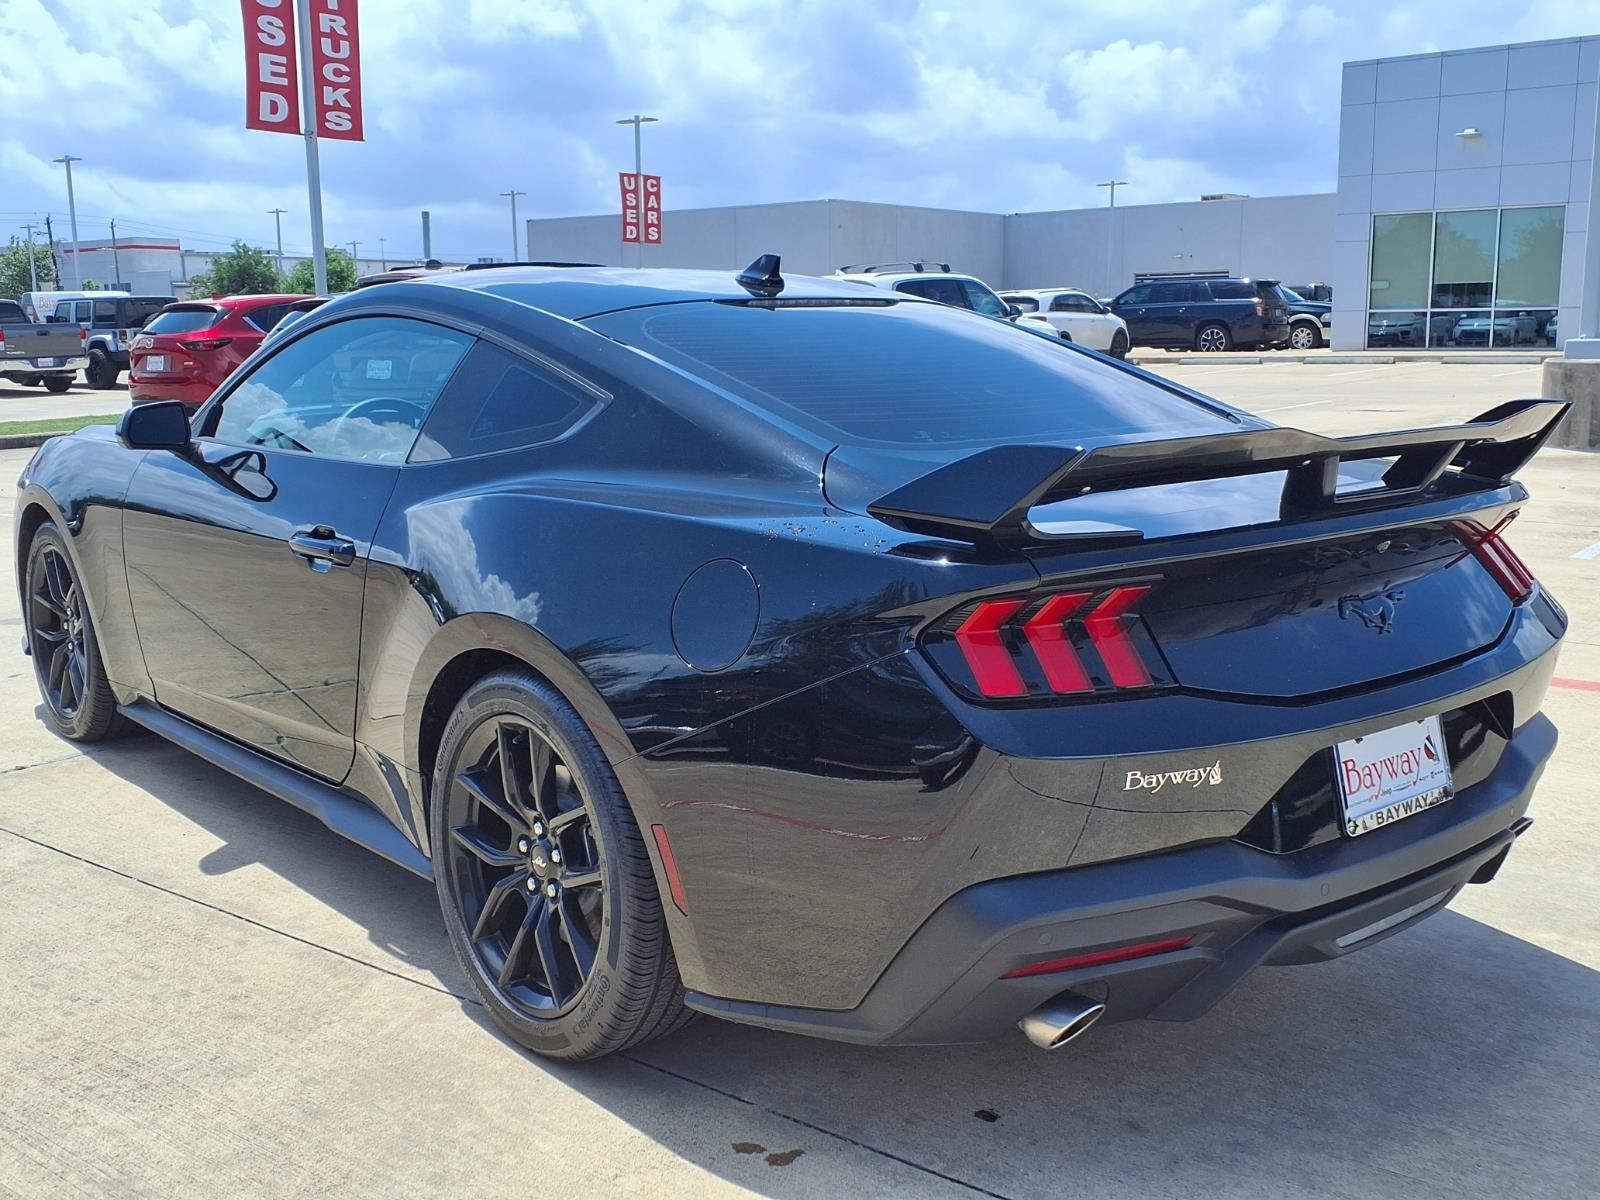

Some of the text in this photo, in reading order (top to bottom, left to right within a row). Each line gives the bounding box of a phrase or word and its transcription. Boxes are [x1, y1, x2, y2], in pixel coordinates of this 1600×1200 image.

[256, 0, 288, 122] SED
[623, 176, 638, 239] USED
[646, 178, 659, 241] CARS
[1122, 766, 1212, 794] Bayway
[1342, 748, 1421, 800] Bayway
[1375, 793, 1429, 825] BAYWAY
